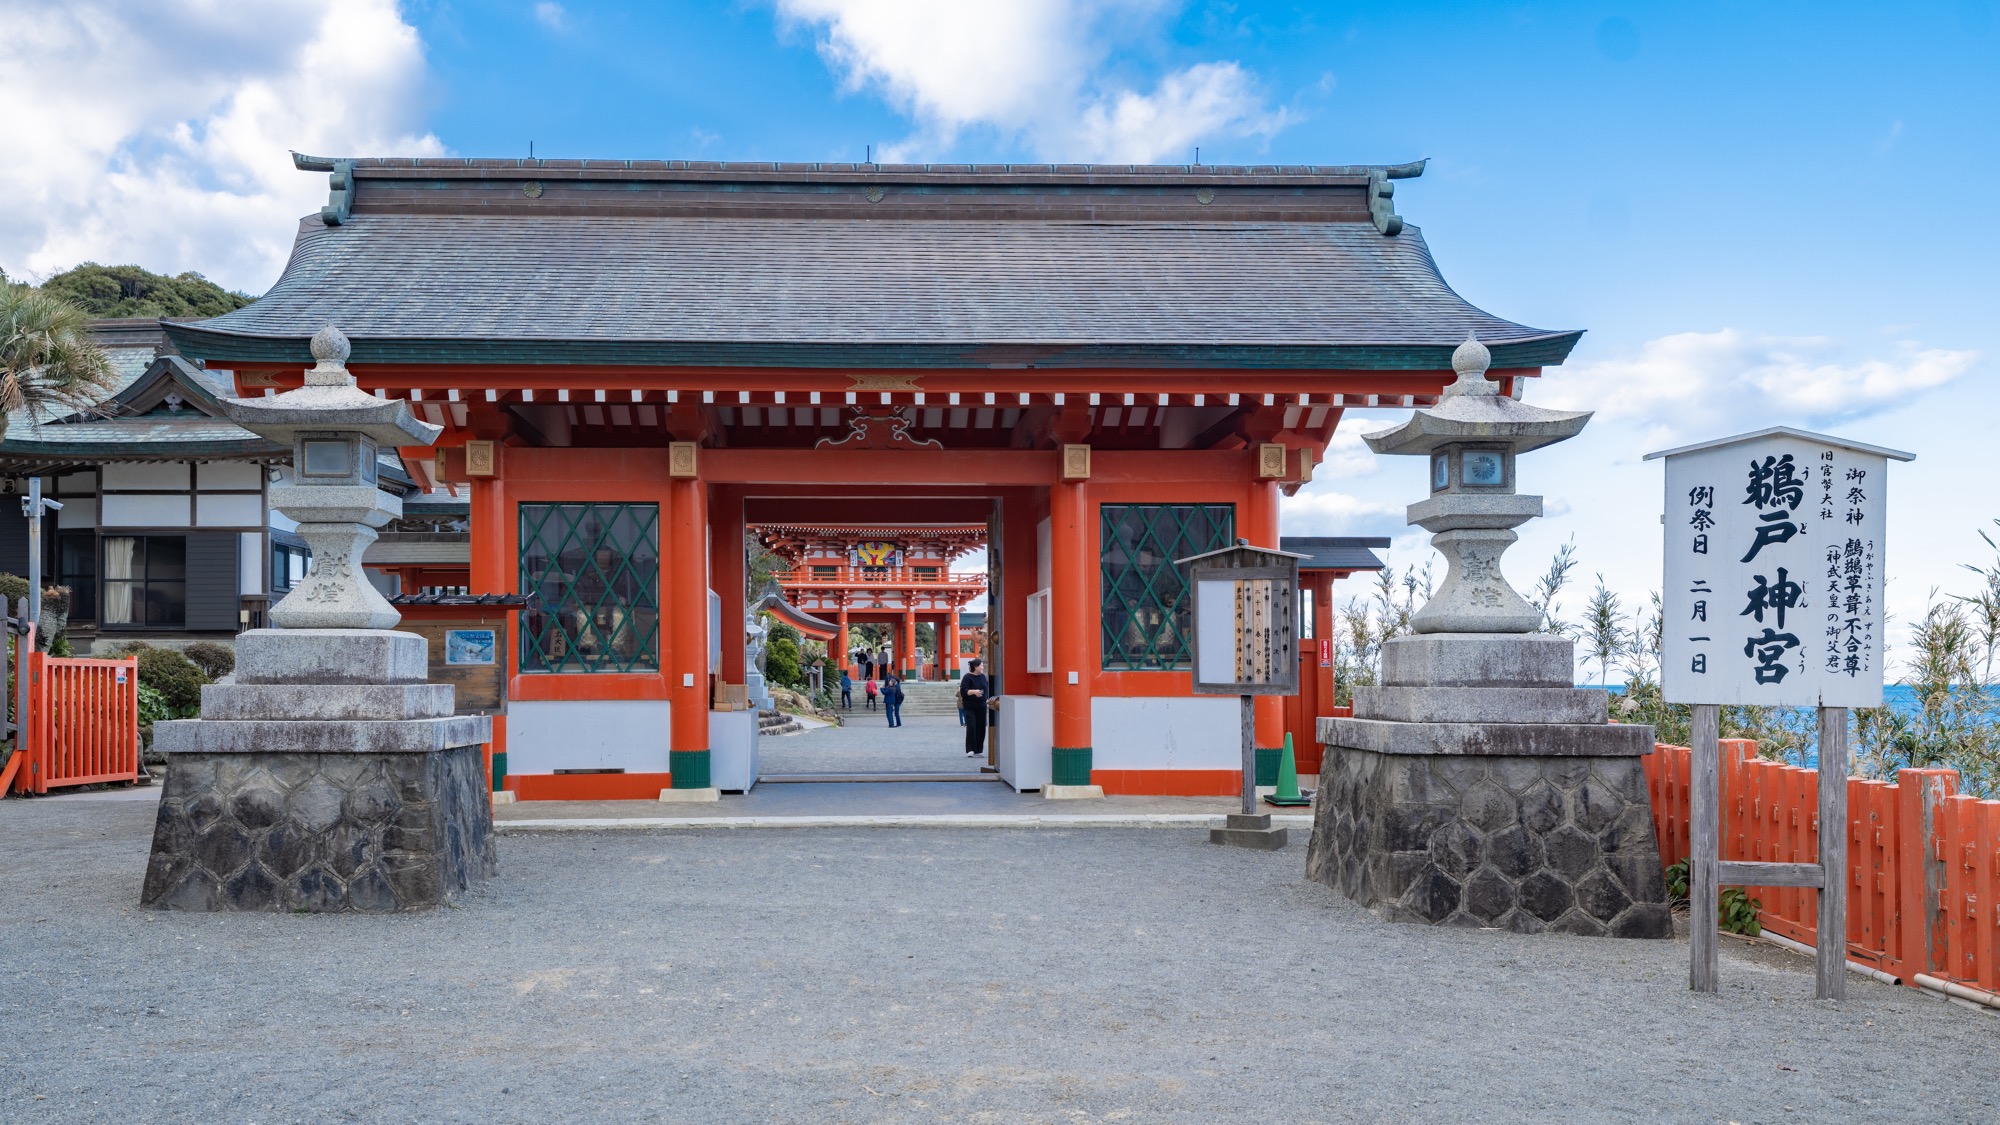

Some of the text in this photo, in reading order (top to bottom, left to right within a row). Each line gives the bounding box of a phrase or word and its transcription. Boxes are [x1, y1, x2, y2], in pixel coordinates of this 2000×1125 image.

[1689, 486, 1715, 674] 例祭日 二月一日
[1739, 454, 1804, 685] 鵜戸神宮
[1846, 468, 1866, 526] 御祭神
